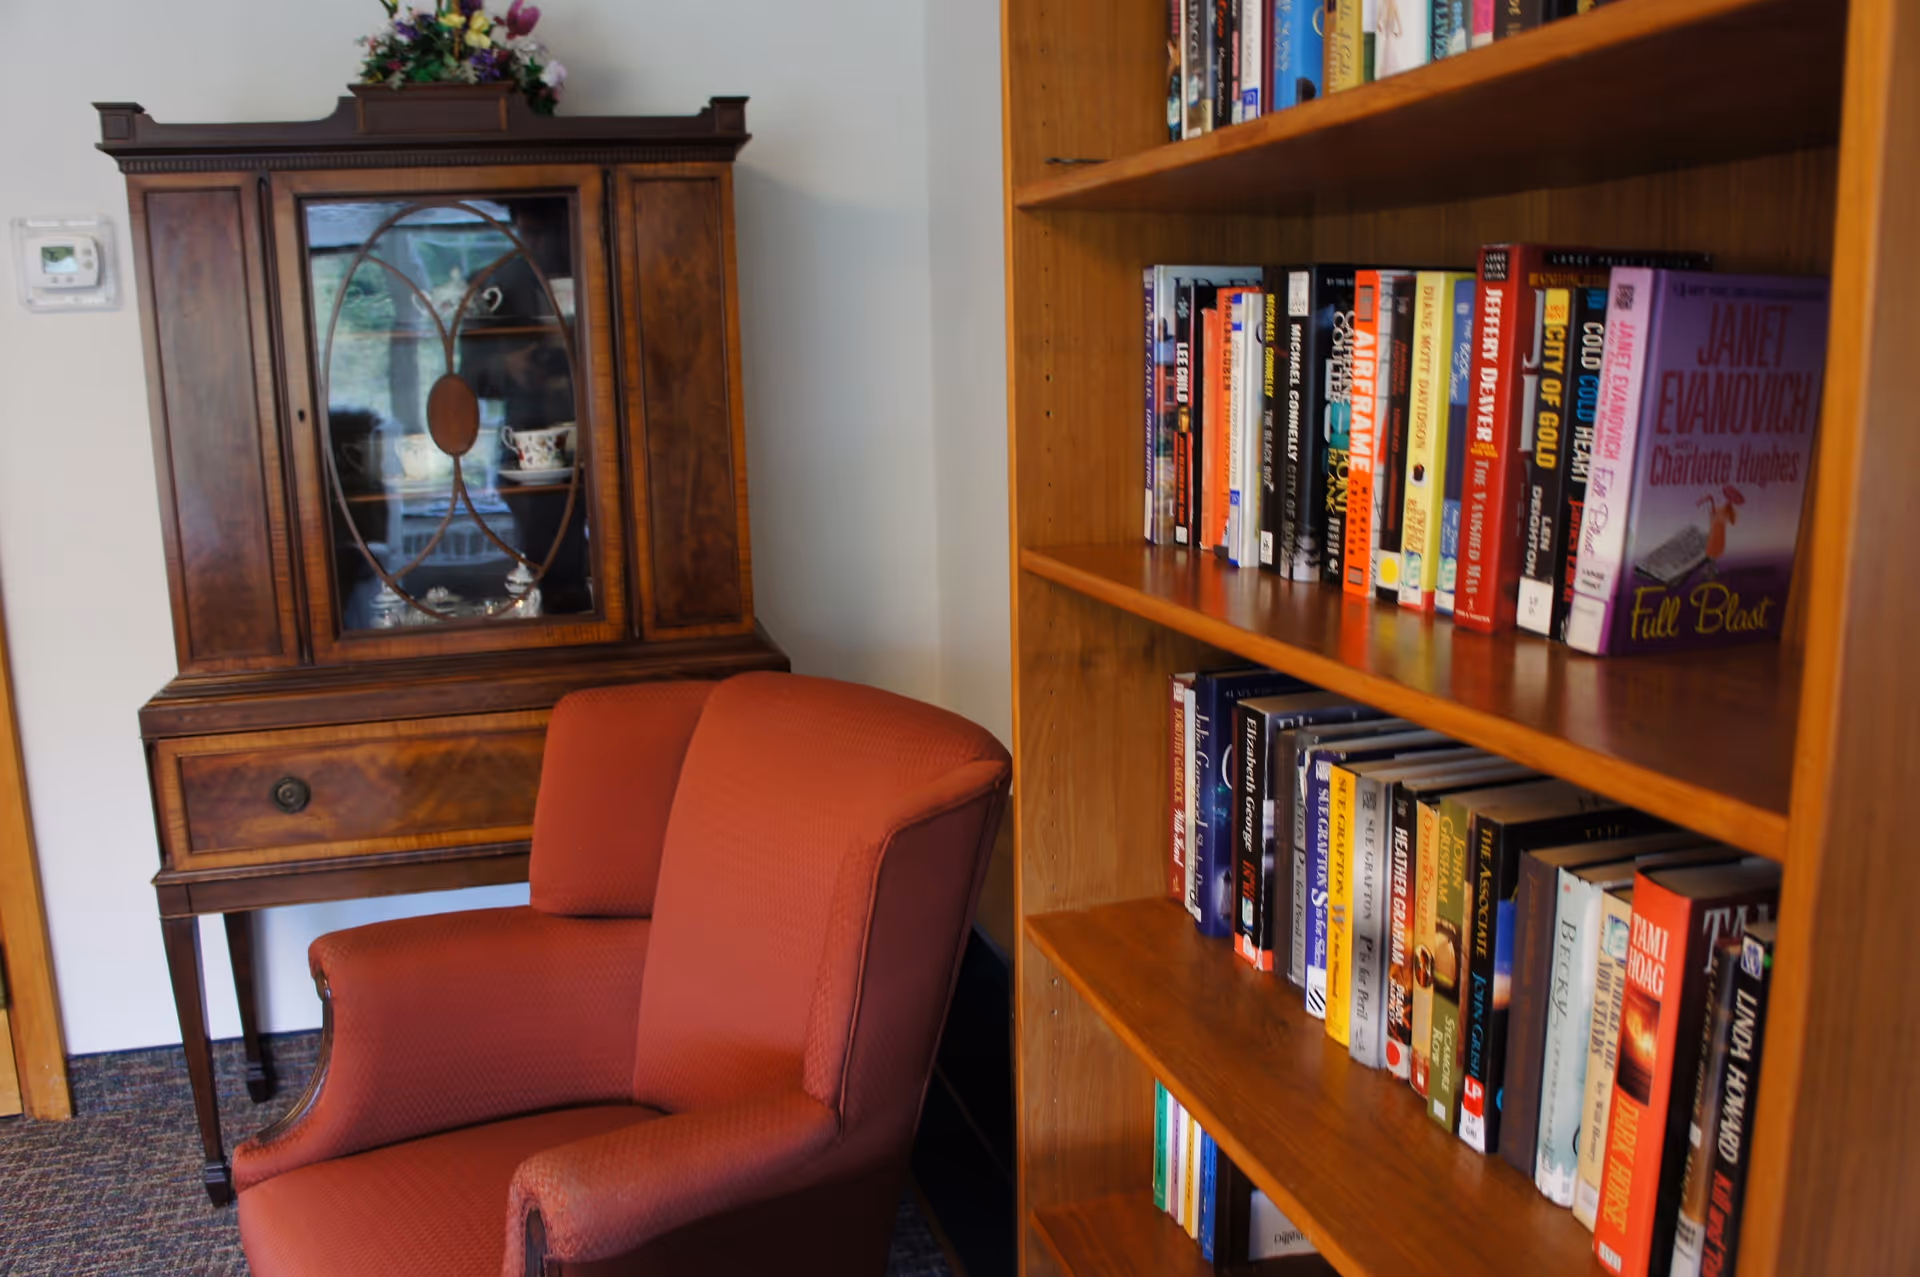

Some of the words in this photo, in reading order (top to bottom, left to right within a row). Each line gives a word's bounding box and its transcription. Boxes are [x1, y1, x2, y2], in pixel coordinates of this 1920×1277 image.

[1264, 294, 1275, 342] MICHAEL
[1421, 286, 1435, 329] DIANE
[1481, 287, 1503, 363] JEFFERY
[1176, 342, 1188, 367] LEE
[1289, 323, 1302, 387] MICHAEL
[1330, 311, 1346, 404] COULTER
[1340, 310, 1356, 403] CATHERINE
[1419, 335, 1432, 375] MOTT
[1542, 325, 1566, 374] CITY
[1580, 321, 1605, 370] COLD
[1614, 318, 1635, 370] JANET
[1696, 302, 1792, 368] JANET
[1176, 367, 1189, 403] CHILD
[1264, 347, 1275, 399] CONNELLY
[1539, 378, 1563, 407] OF
[1576, 374, 1600, 423] COLD
[1286, 390, 1300, 462] CONNELLY
[1349, 329, 1377, 473] AIRFRAME
[1415, 379, 1430, 450] DAVIDSON
[1475, 367, 1499, 452] DEAVER
[1608, 373, 1630, 461] EVANOVICH
[1655, 369, 1813, 435] EVANOVICH
[1263, 429, 1272, 463] BLACK
[1535, 411, 1560, 470] GOLD
[1570, 425, 1596, 484] HEART
[1649, 445, 1733, 487] Charlotte
[1736, 440, 1800, 489] Hughes
[1286, 464, 1297, 497] CITY
[1326, 447, 1339, 515] BLANK
[1334, 449, 1351, 513] POINT
[1473, 459, 1489, 488] THE
[1592, 465, 1615, 498] Full
[1286, 499, 1296, 520] OF
[1349, 479, 1359, 556] CRICHTON
[1359, 486, 1368, 554] MICHAEL
[1467, 491, 1487, 561] VANISHED
[1525, 485, 1543, 577] DEIGHTON
[1540, 515, 1552, 551] LEN
[1583, 503, 1609, 563] Blast
[1465, 562, 1482, 595] MAN
[1630, 586, 1682, 640] Full
[1689, 583, 1773, 634] Blast
[1173, 707, 1185, 758] DOROTHY
[1245, 715, 1257, 794] Elizabeth
[1173, 757, 1184, 805] GARLOCK
[1318, 787, 1330, 818] SUE
[1337, 777, 1348, 810] SUE
[1243, 795, 1257, 854] George
[1364, 818, 1377, 850] SUE
[1480, 828, 1493, 861] THE
[1315, 817, 1329, 887] GRAFTON
[1335, 813, 1347, 897] GRAFTON
[1393, 827, 1409, 894] HEATHER
[1437, 816, 1454, 905] GRISHAM
[1451, 836, 1465, 890] JOHN
[1311, 887, 1329, 908] S
[1362, 850, 1376, 921] GRAFTON
[1475, 862, 1492, 959] ASSOCIATE
[1315, 916, 1325, 937] for
[1331, 903, 1348, 933] W
[1391, 896, 1407, 966] GRAHAM
[1631, 912, 1669, 964] TAMI
[1359, 934, 1374, 958] P
[1551, 919, 1578, 1018] BECKY
[1626, 945, 1665, 998] HOAG
[1358, 967, 1371, 986] for
[1471, 972, 1487, 1021] JOHN
[1596, 961, 1614, 995] NOW
[1355, 987, 1370, 1021] Peril
[1396, 984, 1405, 1026] DEADLY
[1590, 1000, 1611, 1059] STANDS
[1729, 988, 1758, 1062] LINDA
[1431, 1026, 1443, 1068] ROW
[1441, 1016, 1456, 1094] SYCAMORE
[1464, 1078, 1482, 1100] LP
[1716, 1063, 1748, 1165] HOWARD
[1610, 1095, 1641, 1164] DARK
[1601, 1155, 1632, 1236] HORSE
[1713, 1169, 1734, 1216] Kill
[1706, 1203, 1728, 1248] and
